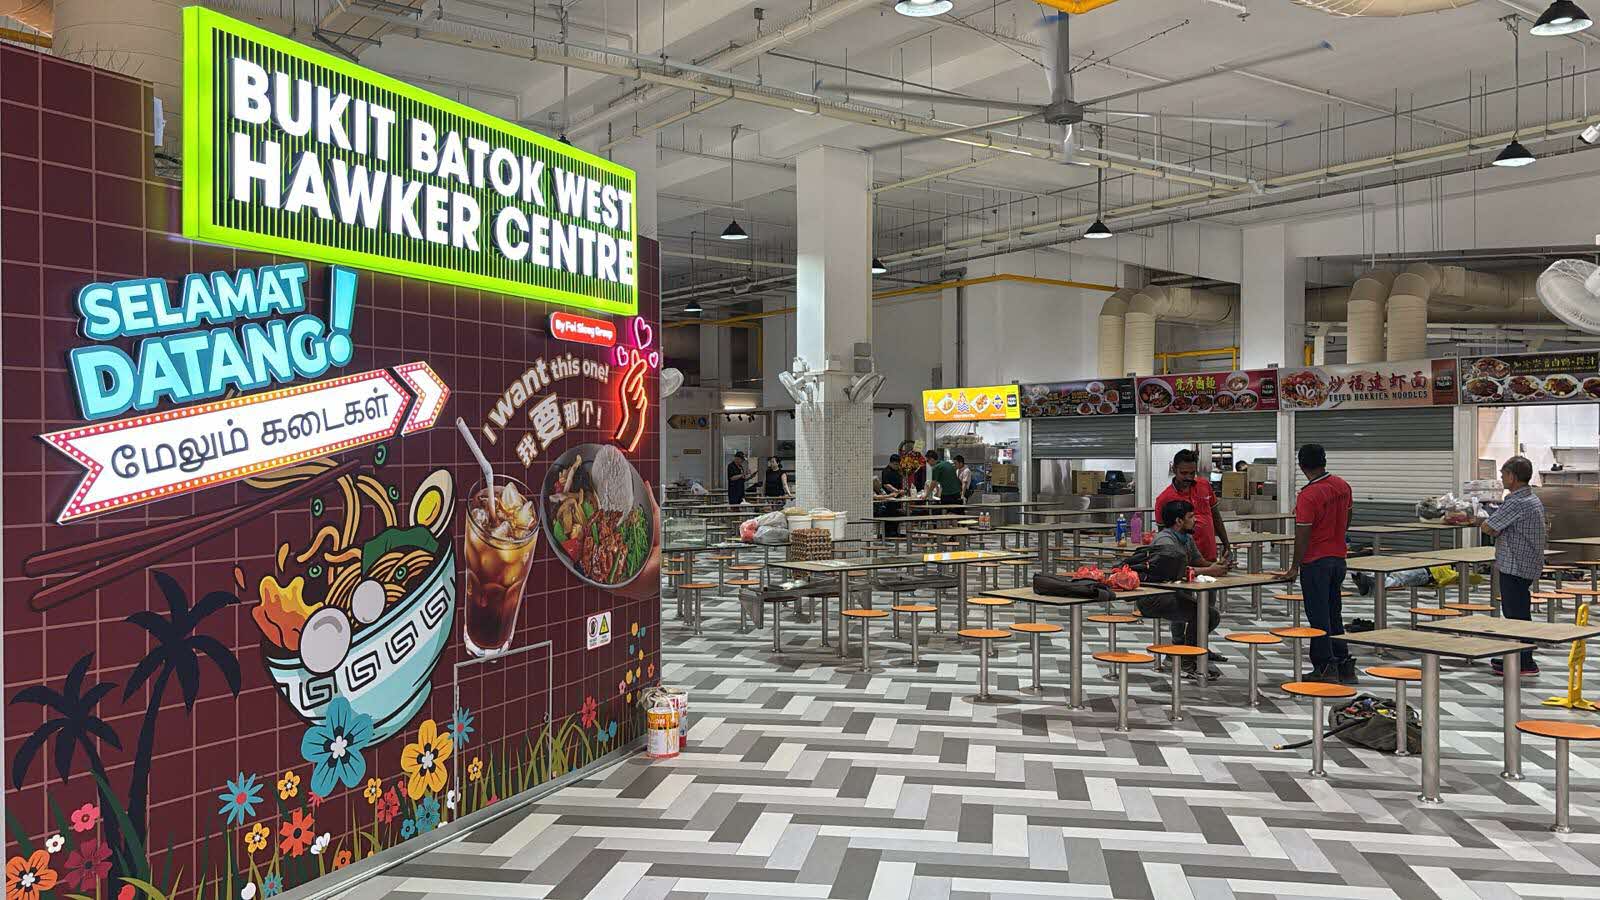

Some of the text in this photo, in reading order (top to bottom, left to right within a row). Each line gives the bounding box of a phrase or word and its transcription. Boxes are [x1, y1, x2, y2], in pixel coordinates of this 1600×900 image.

[232, 57, 632, 232] BUKIT BATOK WEST
[232, 132, 633, 286] HAWKER CENTRE
[73, 265, 358, 418] DATANG!
[78, 265, 307, 338] SELAMAT
[555, 319, 566, 333] By
[577, 323, 595, 338] Siong
[595, 327, 613, 340] Group
[483, 353, 609, 445] I want this one!
[1327, 370, 1427, 394] 炒福建虾面
[1328, 390, 1428, 402] FRIED HOKKIEN NOODLES
[111, 387, 391, 479] மேலும் கடைகள்
